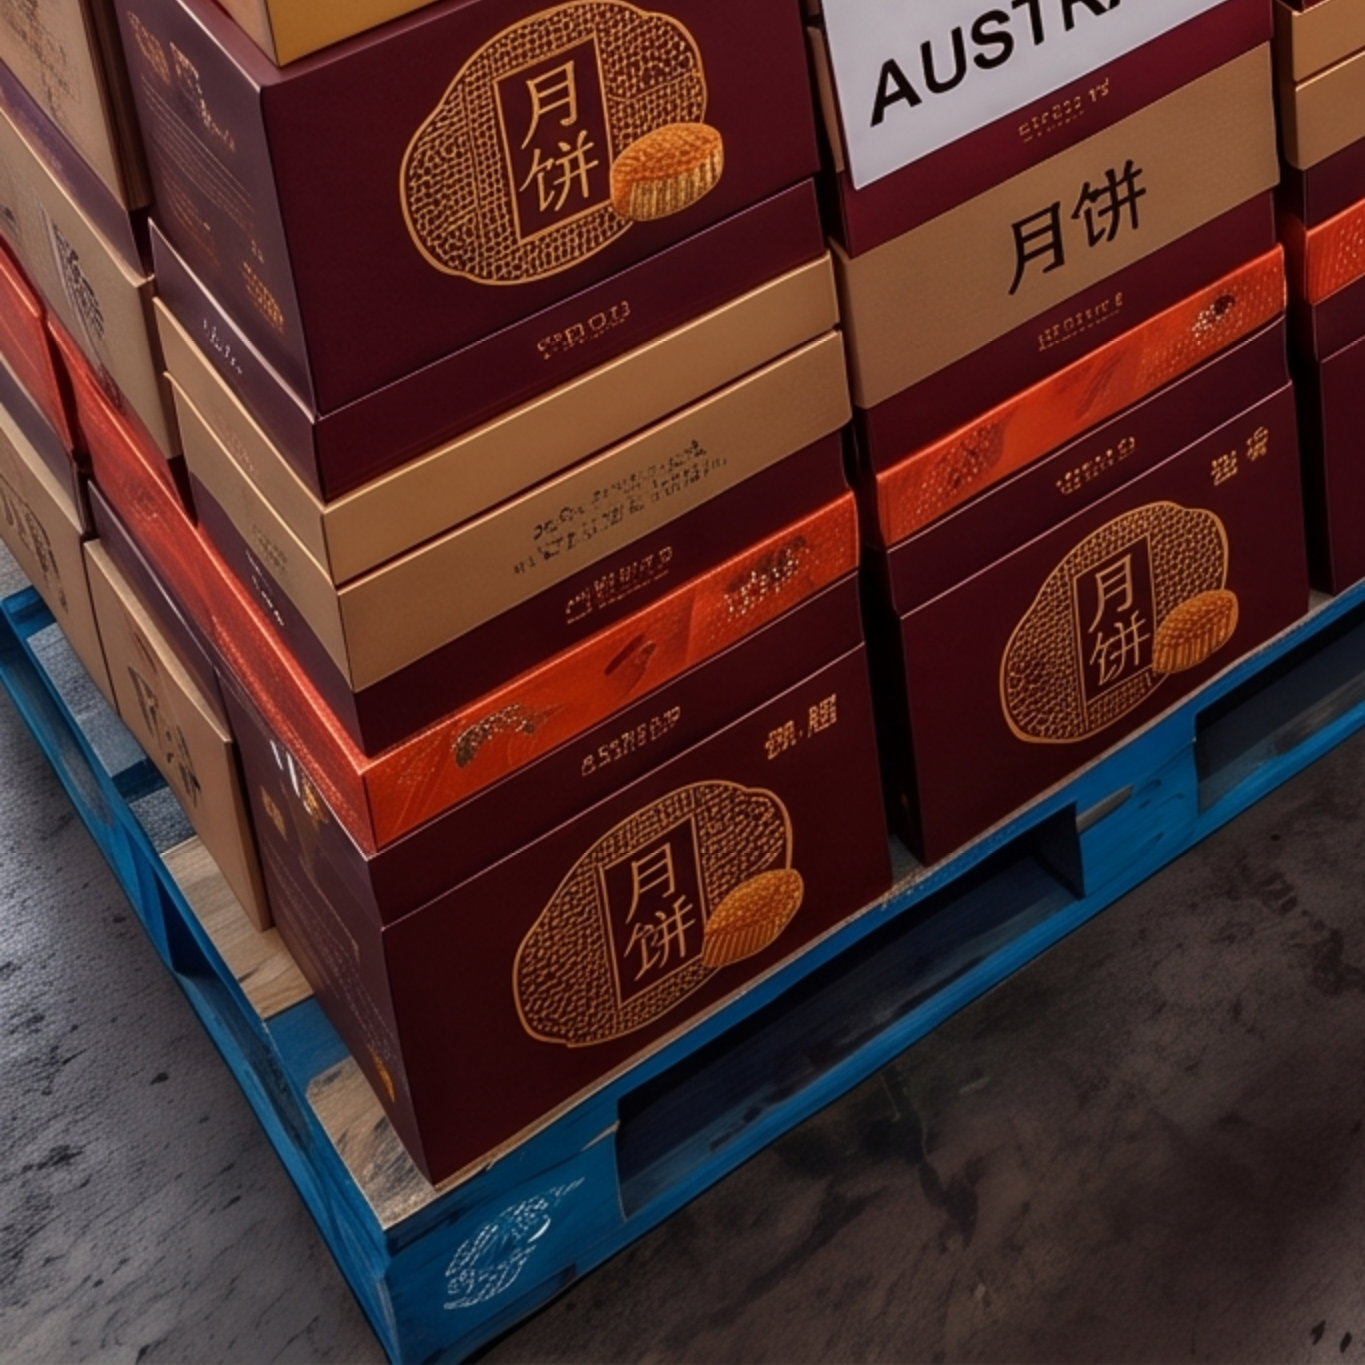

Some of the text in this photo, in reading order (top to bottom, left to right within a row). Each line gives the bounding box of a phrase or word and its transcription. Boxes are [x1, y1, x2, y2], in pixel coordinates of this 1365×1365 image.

[519, 61, 597, 212] 月饼
[1009, 160, 1146, 295] 月饼
[1090, 554, 1149, 685] 月饼
[627, 846, 703, 979] 月饼
